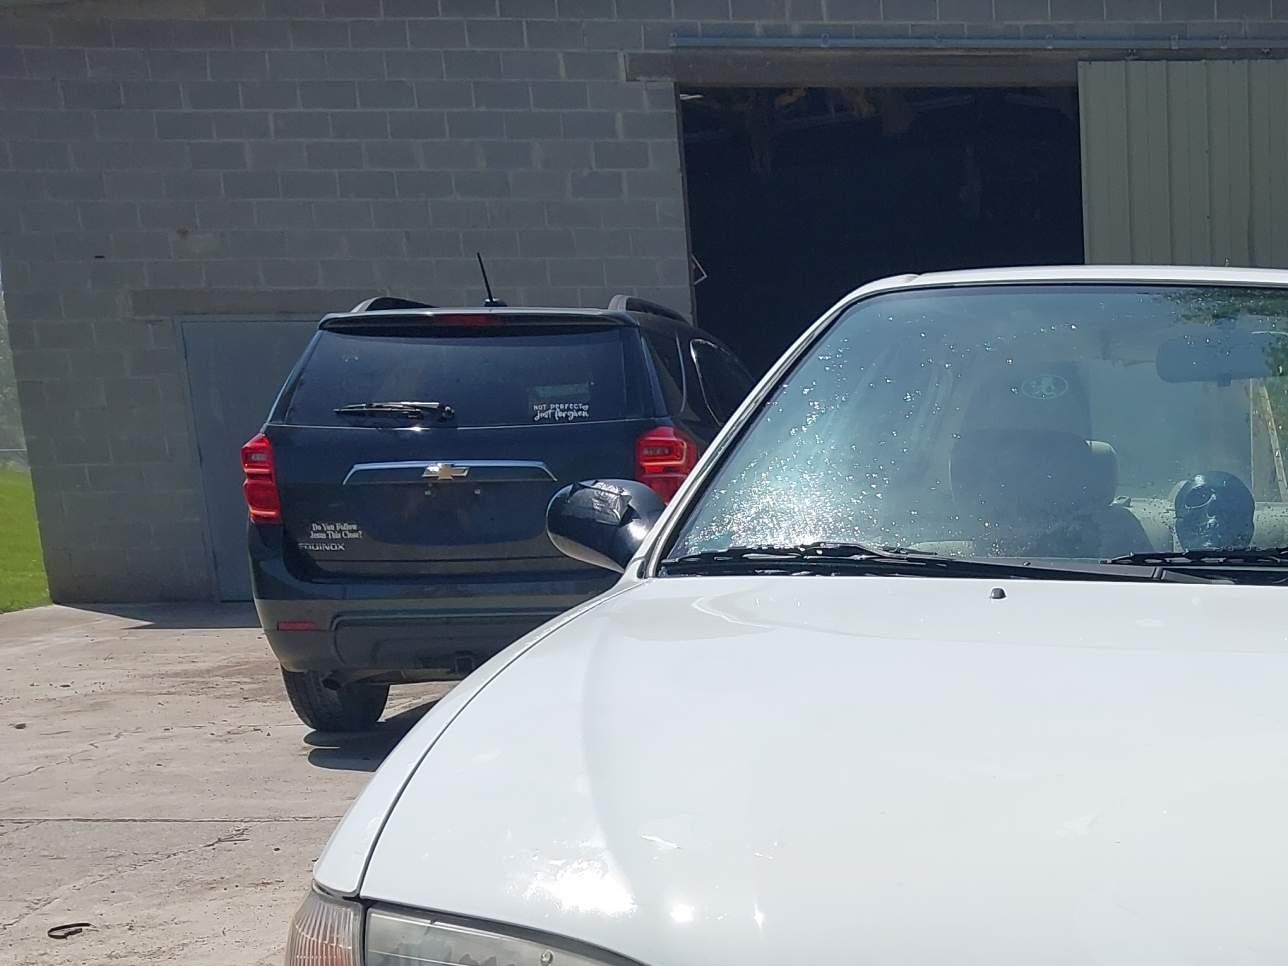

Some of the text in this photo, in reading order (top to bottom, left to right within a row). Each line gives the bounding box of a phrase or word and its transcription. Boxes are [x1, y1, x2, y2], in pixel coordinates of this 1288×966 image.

[312, 523, 322, 531] Do
[322, 523, 335, 531] You
[310, 530, 362, 539] Jesus This Close?
[298, 542, 345, 551] EQUINOX
